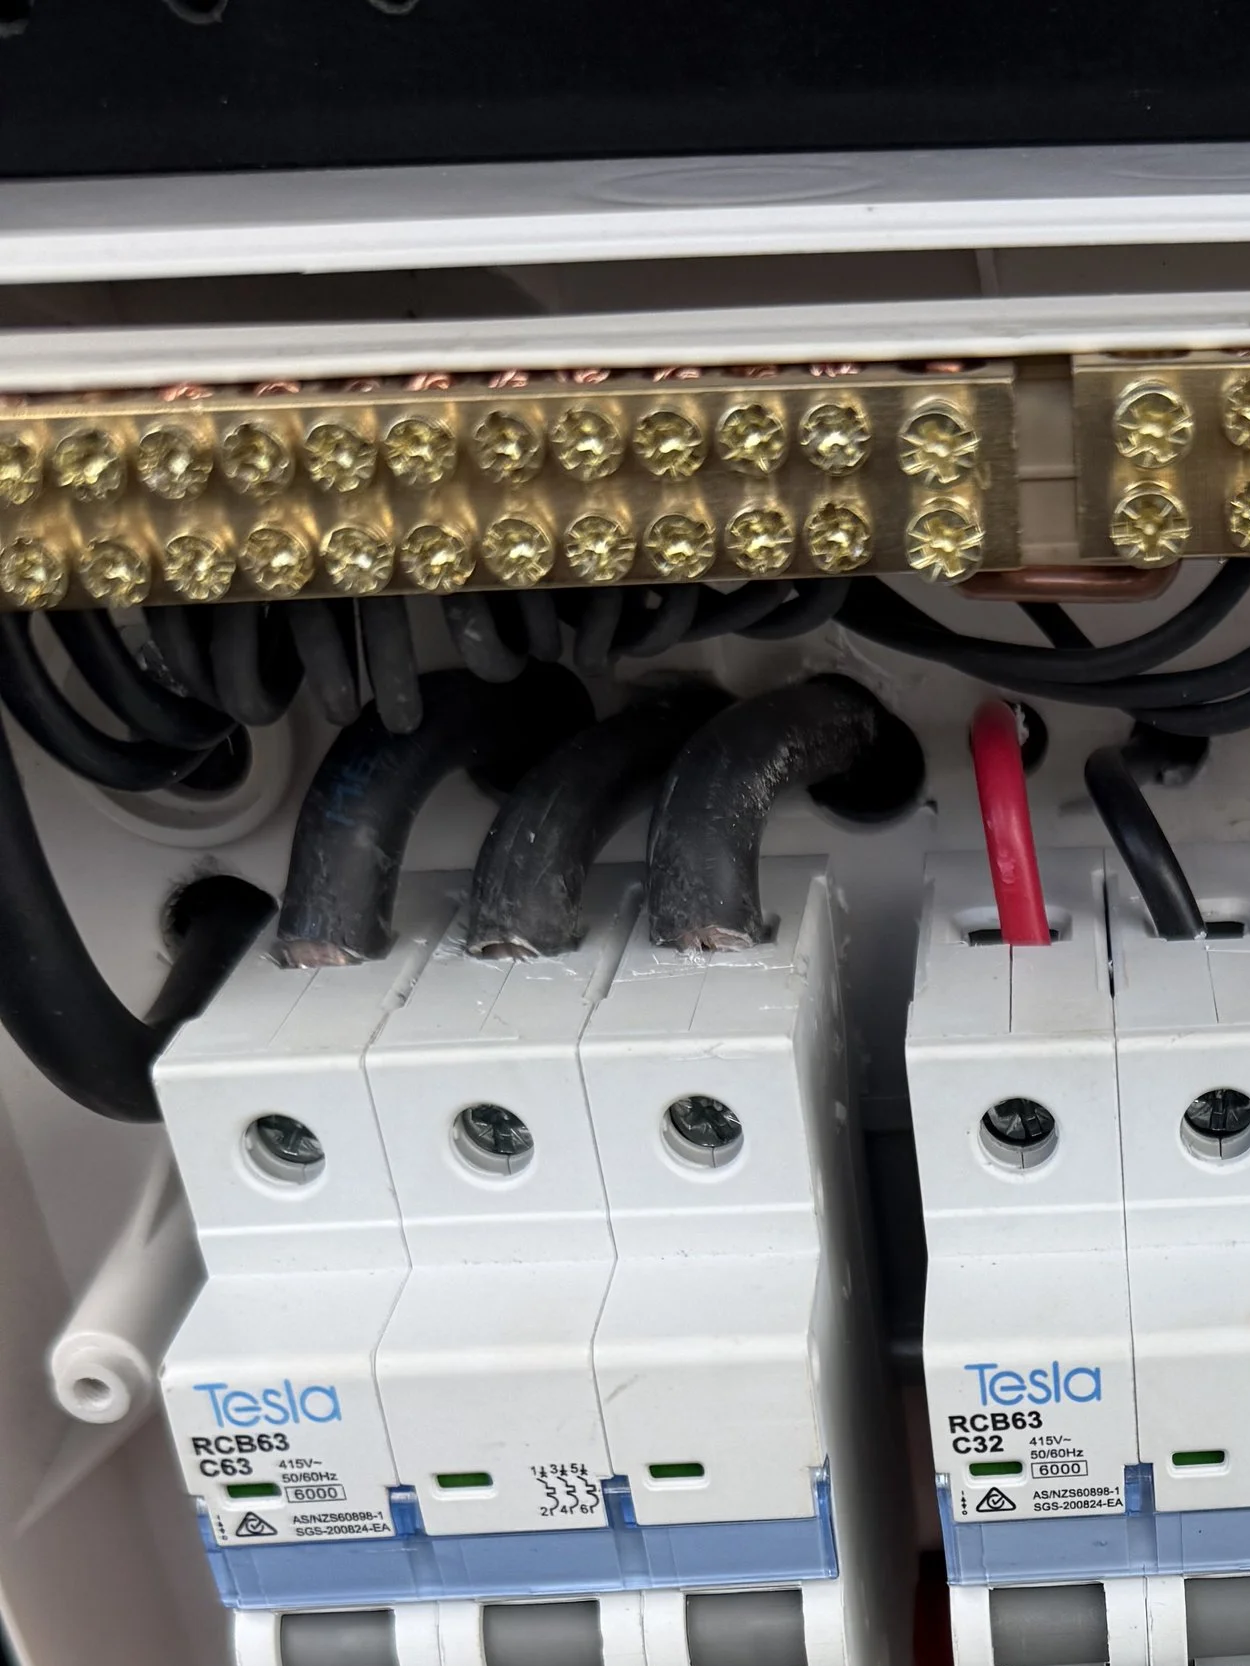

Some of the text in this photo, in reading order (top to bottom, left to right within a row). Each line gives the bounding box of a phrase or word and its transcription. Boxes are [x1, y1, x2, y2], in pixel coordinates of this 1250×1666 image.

[964, 1360, 1102, 1407] Tesla
[193, 1378, 342, 1428] Tesla
[948, 1410, 1043, 1434] RCB63
[191, 1433, 290, 1456] RCB63
[952, 1435, 1004, 1455] C32
[1030, 1448, 1084, 1460] 50/60Hz
[200, 1457, 253, 1478] C63
[550, 1463, 558, 1474] 3
[570, 1462, 579, 1474] 5
[1039, 1463, 1081, 1476] 6000
[282, 1471, 338, 1484] 50/60Hz
[294, 1487, 338, 1501] 6000
[1033, 1486, 1120, 1500] AS/NZS60898-1
[540, 1504, 589, 1517] 2 4 6
[1033, 1498, 1124, 1512] SGS-200824-EA
[292, 1511, 384, 1525] AS/NZS60898-1
[296, 1523, 391, 1537] SGS-200824-EA
